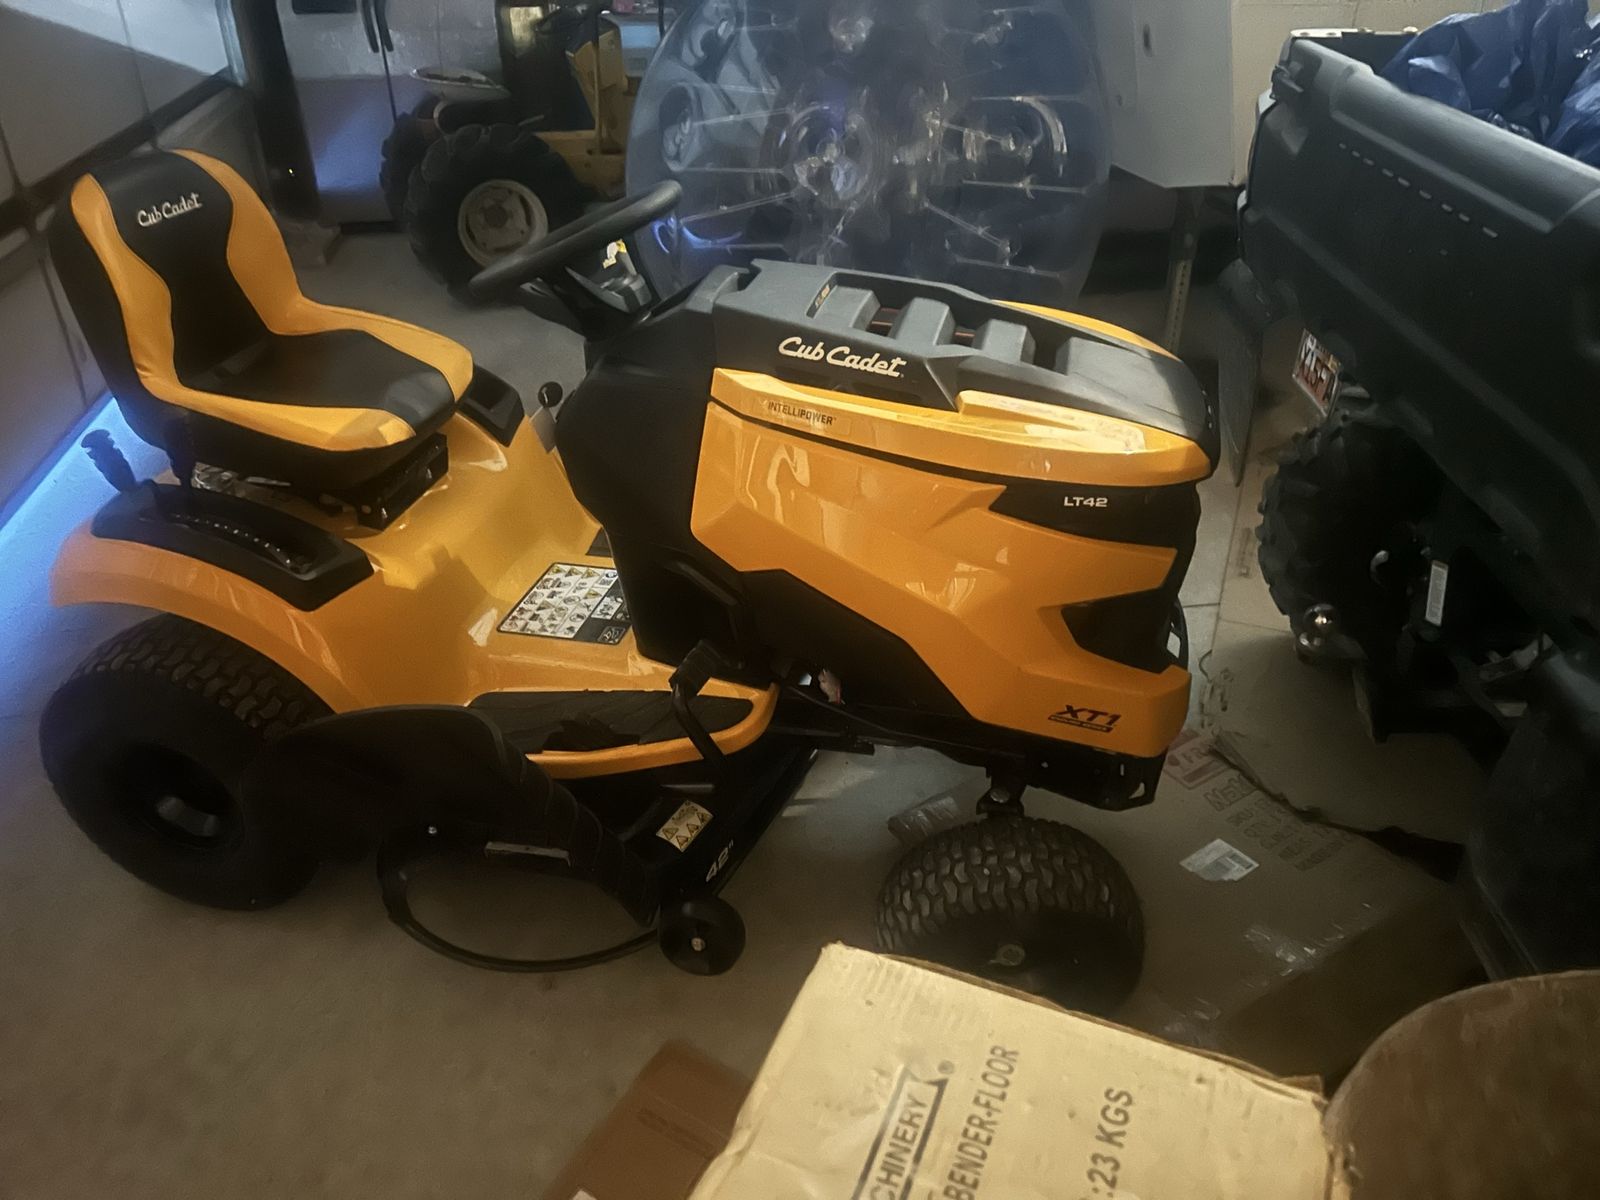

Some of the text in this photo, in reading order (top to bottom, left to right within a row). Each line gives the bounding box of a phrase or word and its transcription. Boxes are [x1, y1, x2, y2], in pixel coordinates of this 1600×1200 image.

[137, 192, 203, 227] Cub Cadet
[778, 336, 907, 378] Cub Cadet
[1063, 496, 1109, 508] LT42
[1055, 704, 1122, 726] XT1
[1095, 1087, 1133, 1149] KGS
